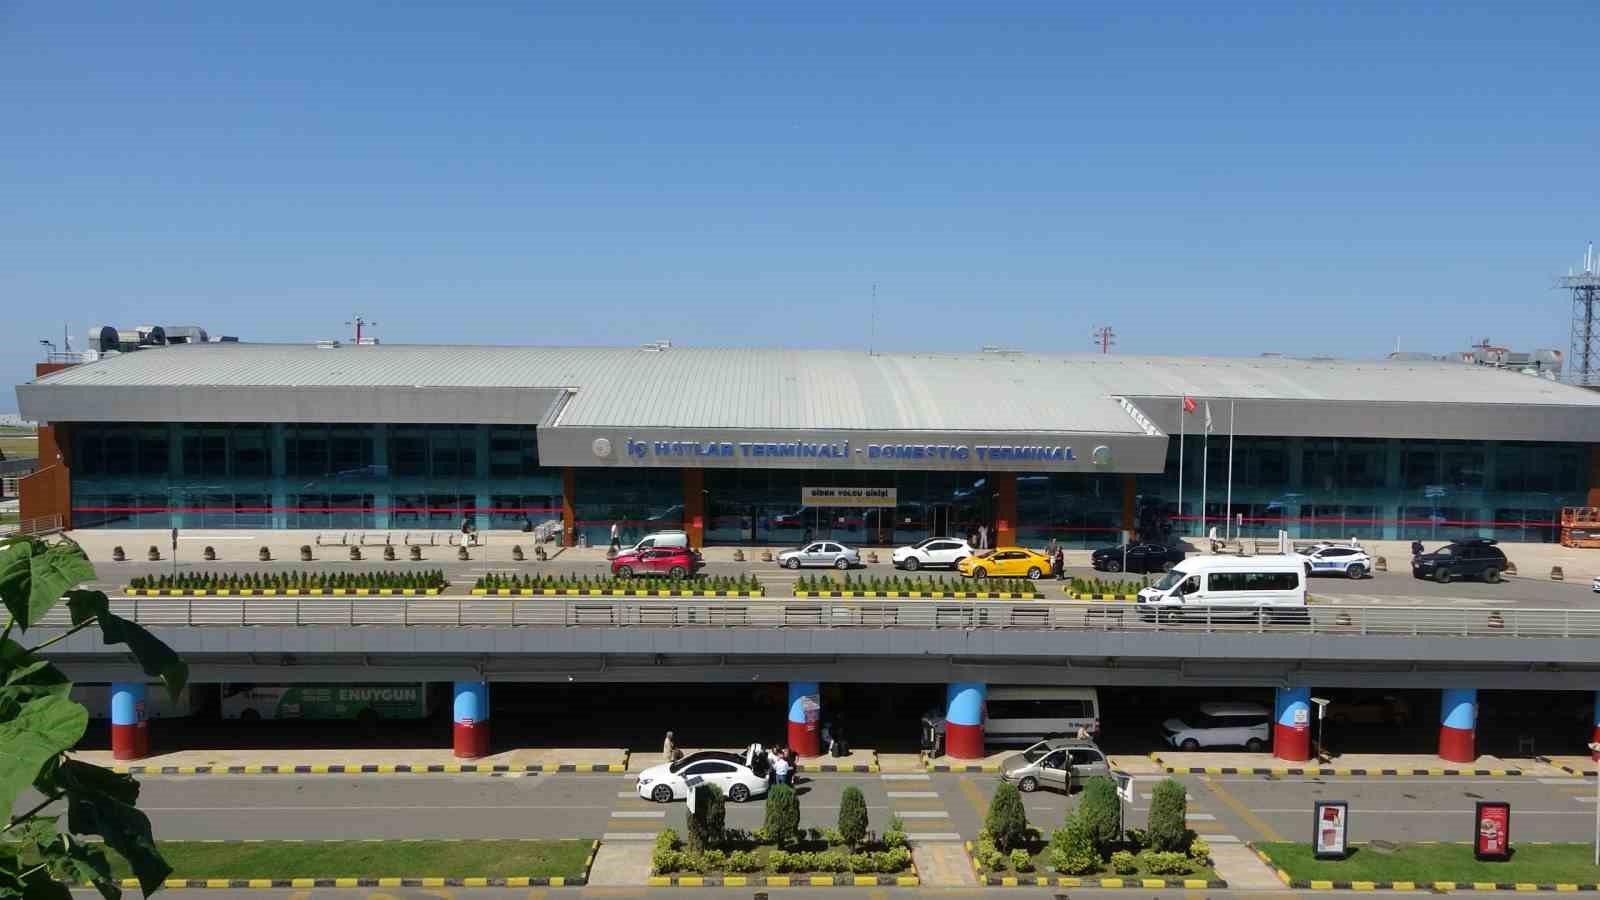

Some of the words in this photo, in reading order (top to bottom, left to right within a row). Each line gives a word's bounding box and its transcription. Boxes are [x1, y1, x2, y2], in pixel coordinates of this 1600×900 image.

[626, 437, 647, 458] İÇ
[655, 440, 733, 458] HATLAR
[738, 440, 849, 459] TERMİNALİ
[867, 444, 969, 460] DOMESTIC
[975, 445, 1077, 462] TERMINAL
[338, 687, 417, 702] ENUYGUN
